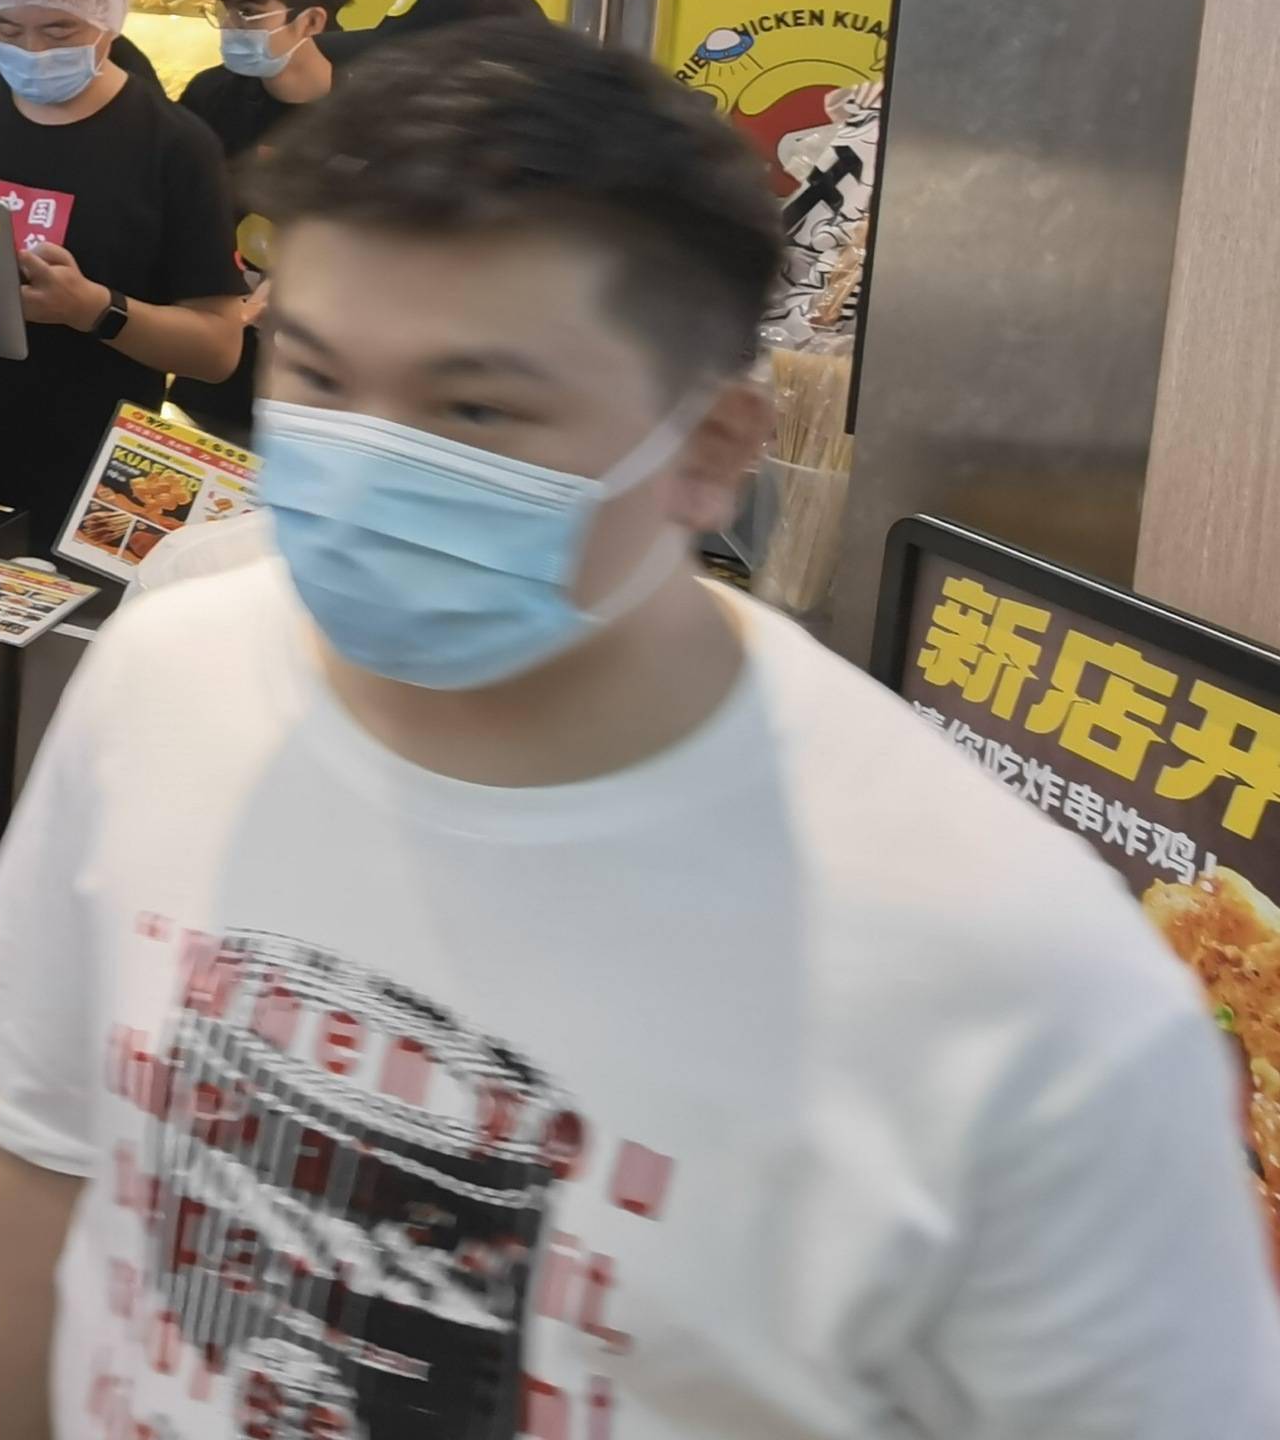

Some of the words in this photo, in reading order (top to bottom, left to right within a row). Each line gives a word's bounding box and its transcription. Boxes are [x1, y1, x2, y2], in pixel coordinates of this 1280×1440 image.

[732, 9, 825, 38] HICKEN
[910, 699, 1219, 894] 你吃炸串炸鸡!
